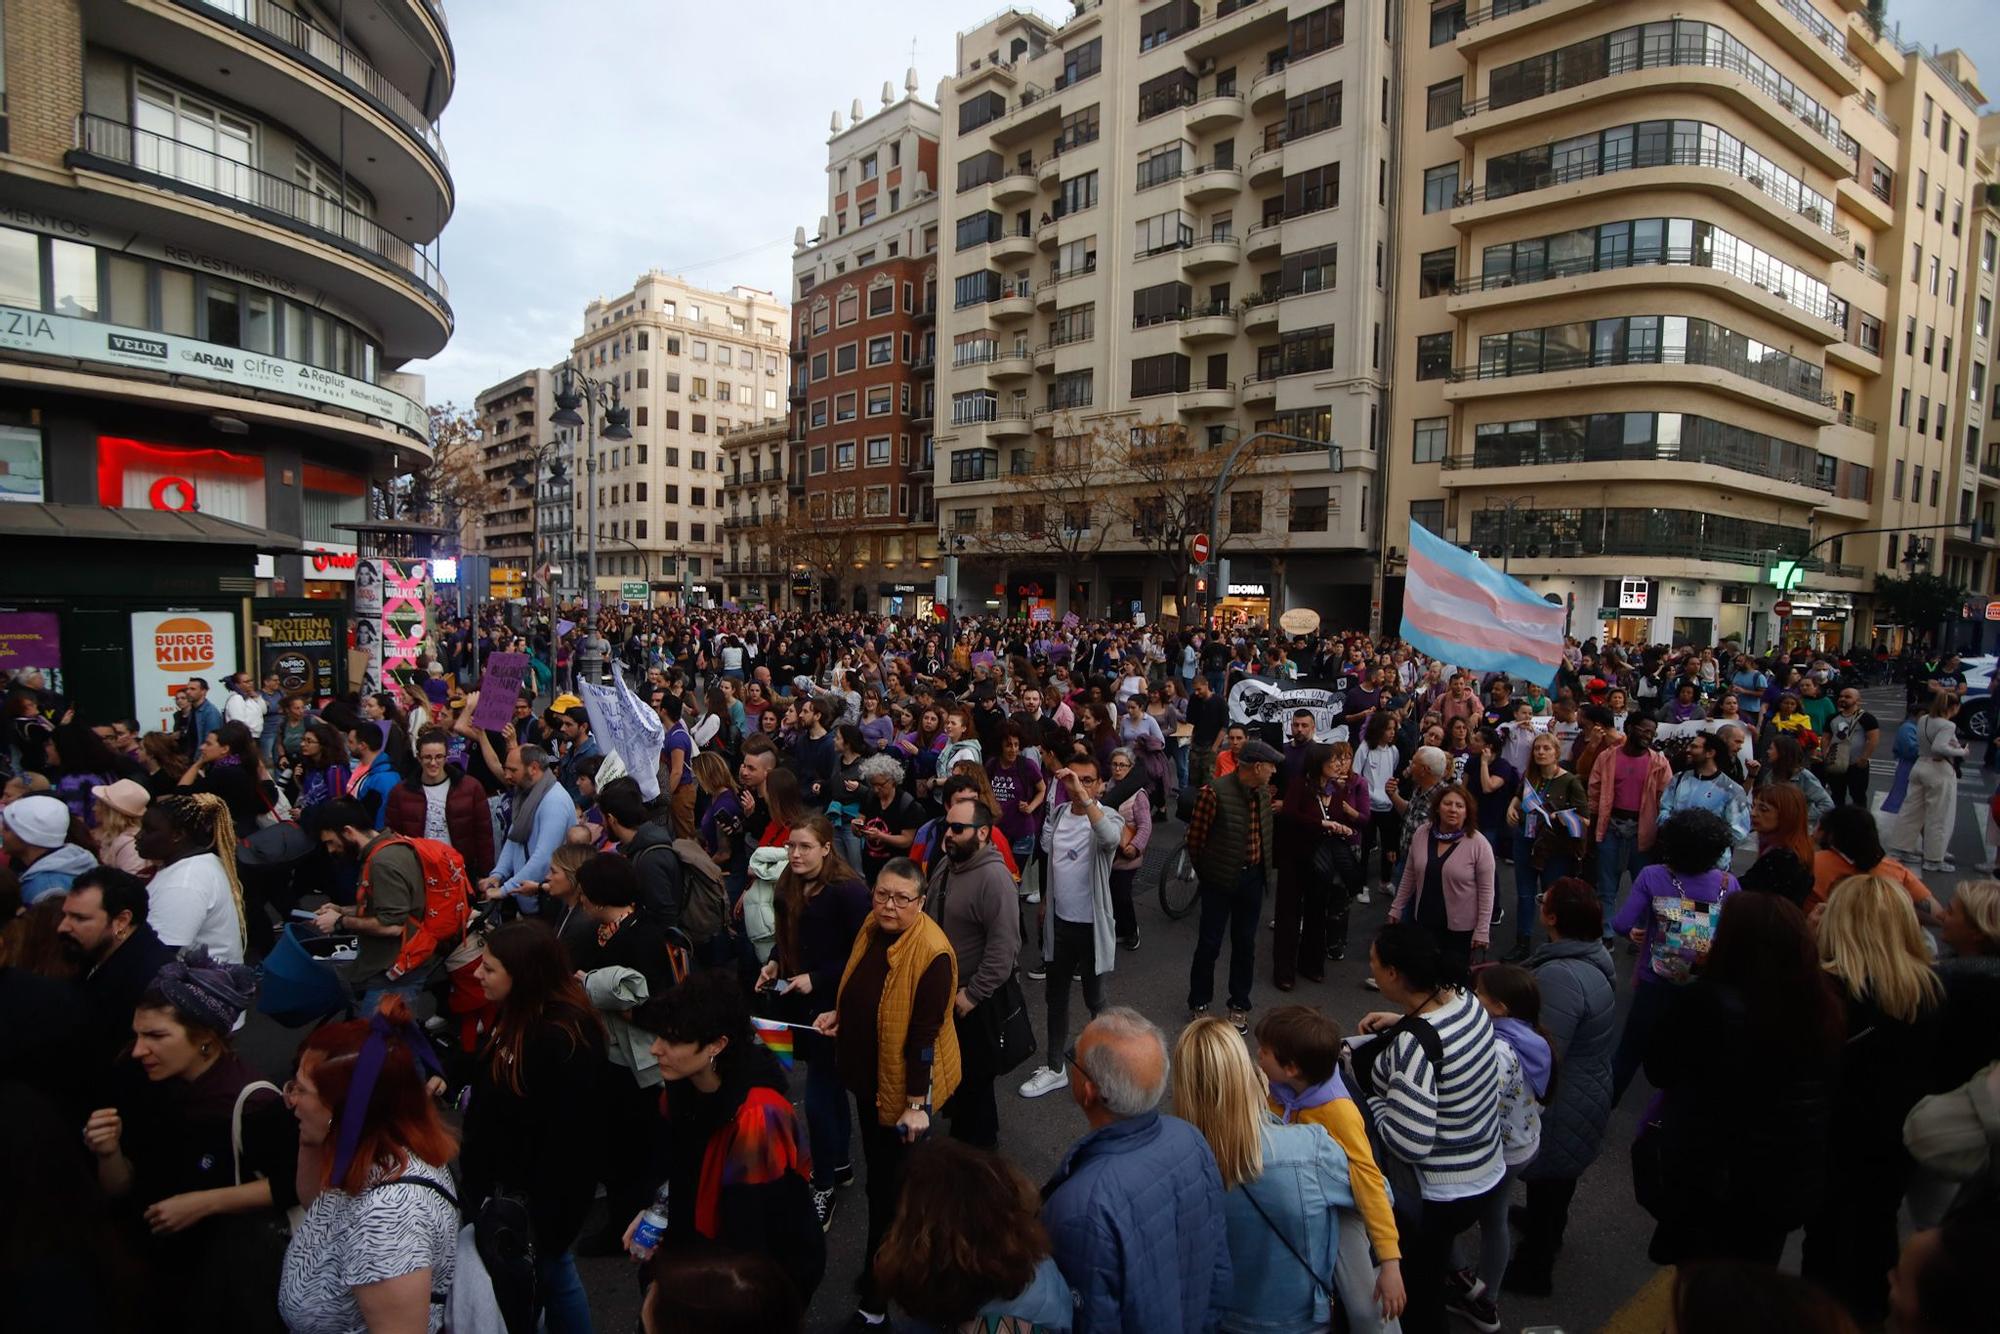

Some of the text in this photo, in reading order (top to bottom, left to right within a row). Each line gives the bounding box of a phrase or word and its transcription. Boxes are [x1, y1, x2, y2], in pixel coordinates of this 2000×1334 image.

[164, 245, 297, 295] REVESTIMIENTOS
[0, 311, 55, 341] ZIA
[112, 337, 166, 356] VELUX
[193, 352, 234, 370] ARAN
[311, 369, 345, 389] Replus
[155, 634, 214, 646] BURGER
[156, 646, 214, 662] KING
